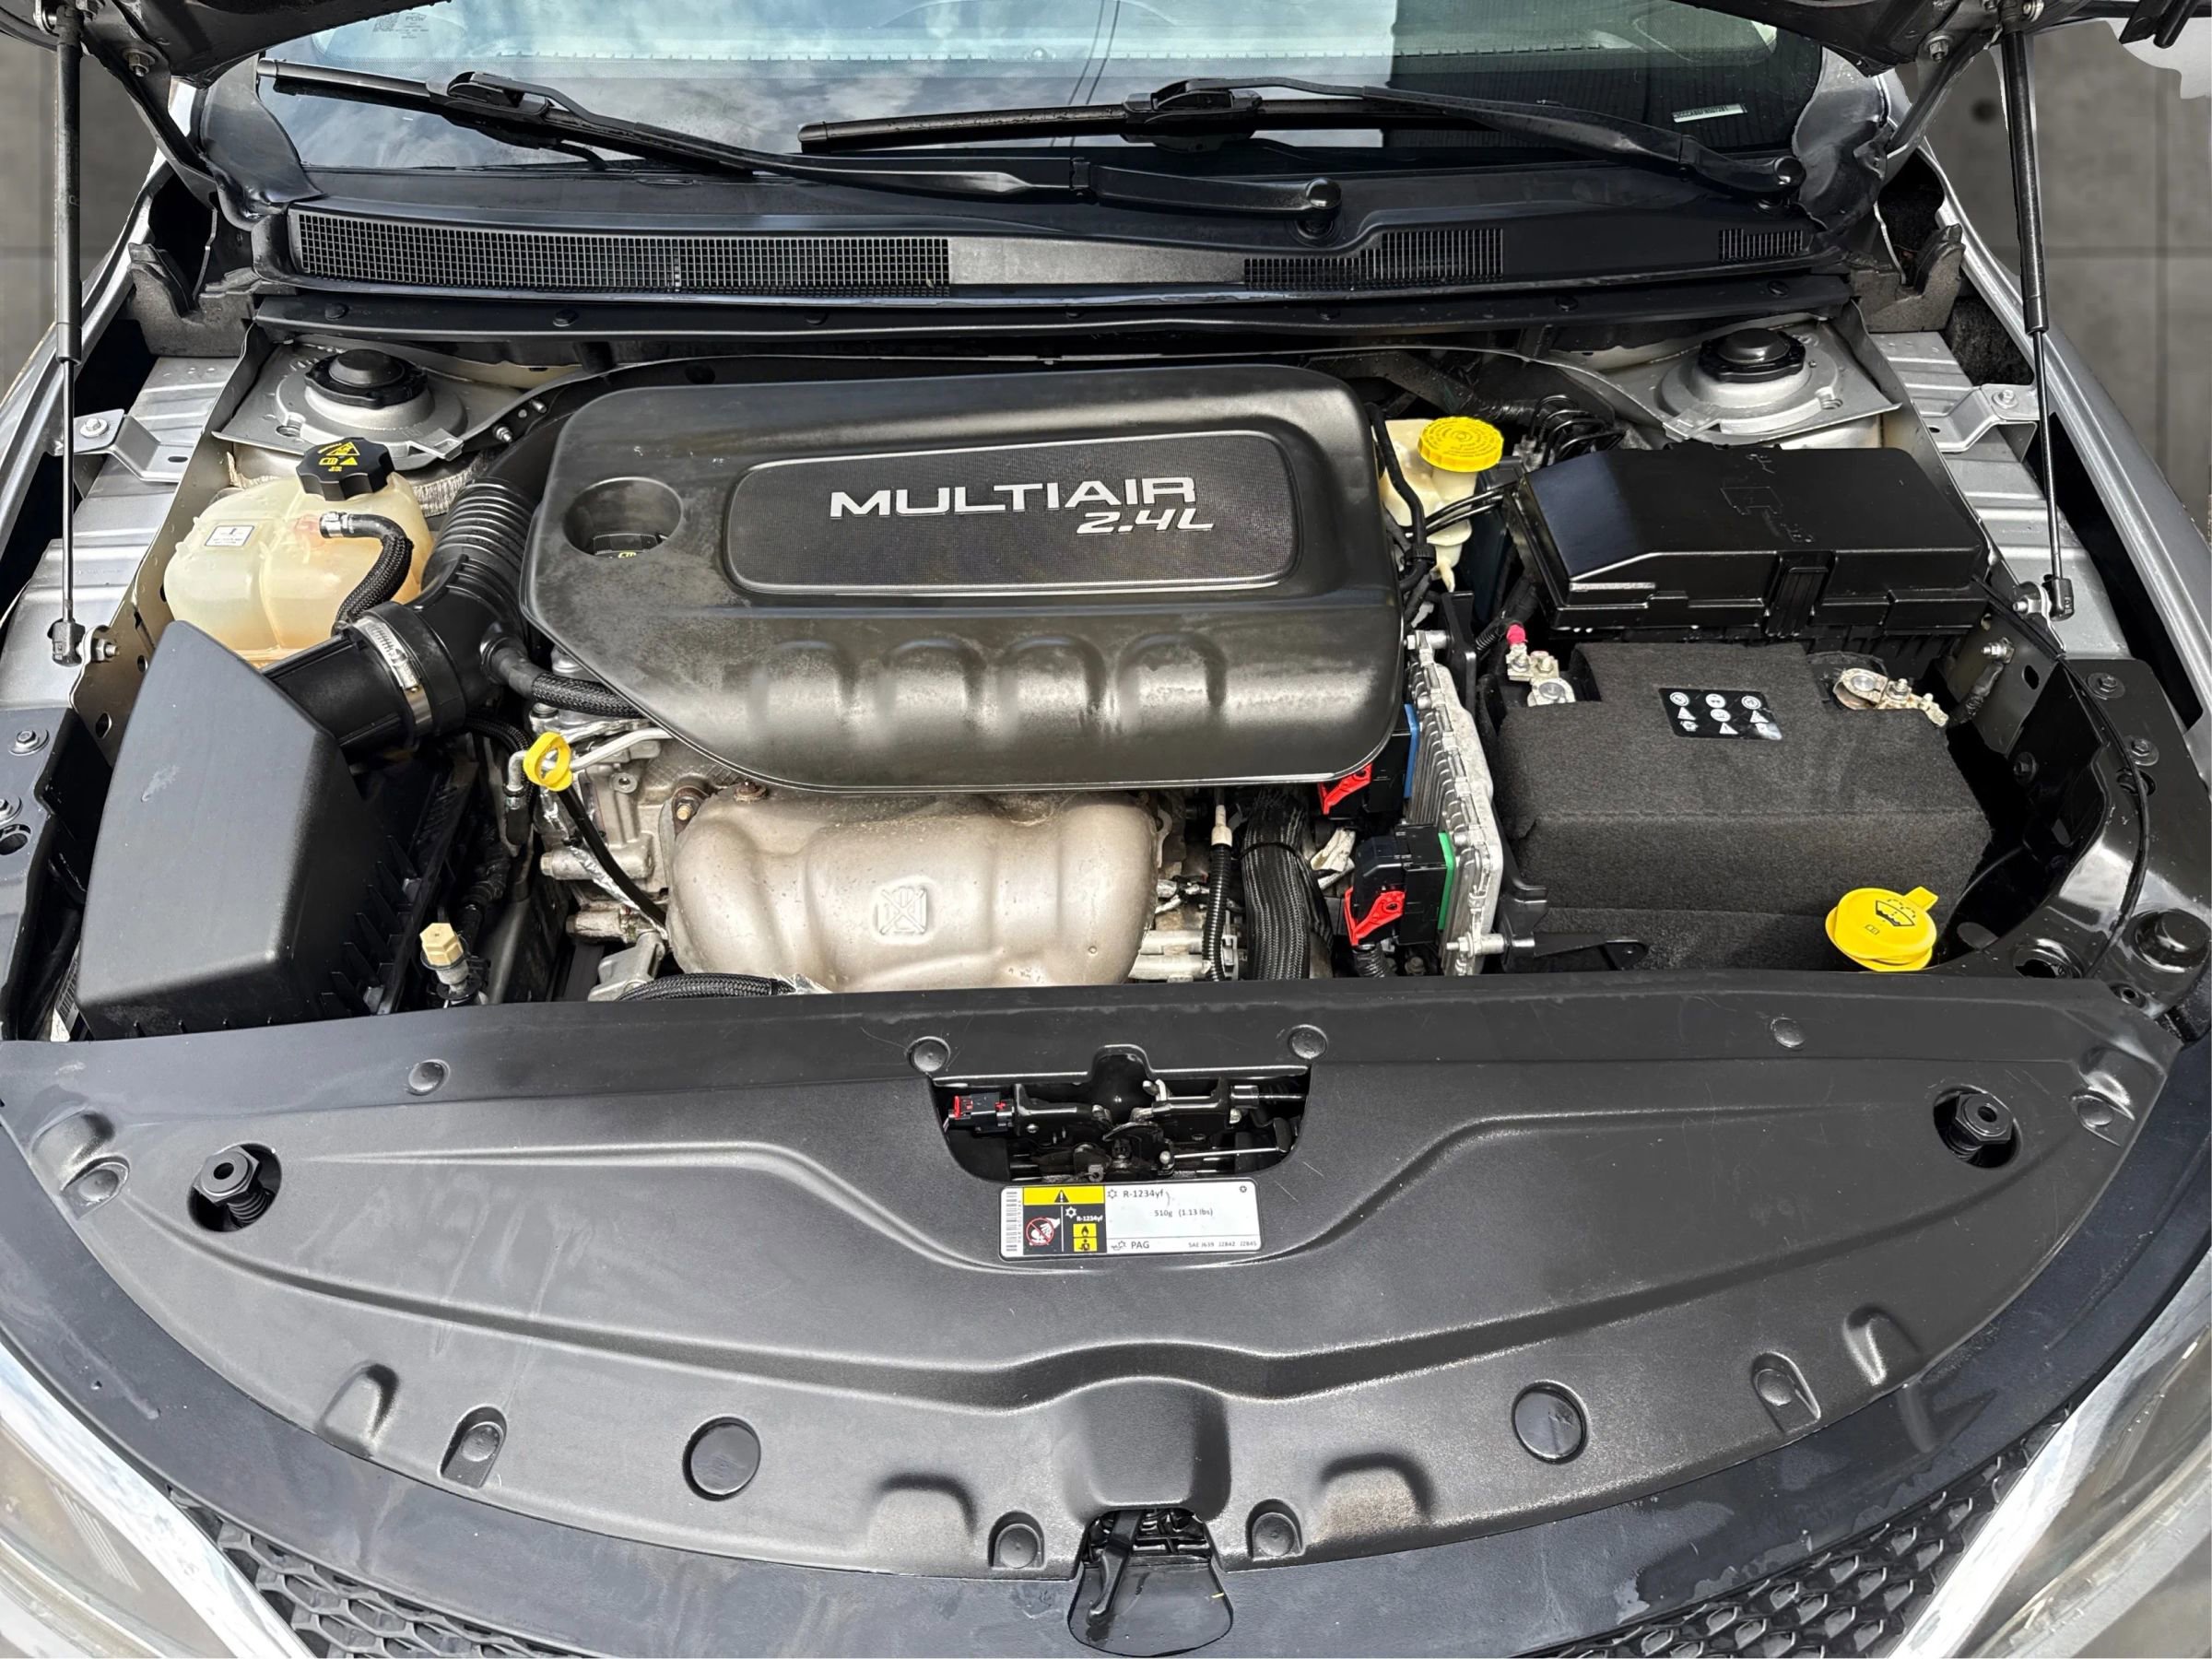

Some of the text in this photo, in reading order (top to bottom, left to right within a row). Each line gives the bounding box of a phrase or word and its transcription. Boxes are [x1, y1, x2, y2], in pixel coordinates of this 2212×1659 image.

[830, 477, 1196, 519] MULTIAIR
[1077, 508, 1215, 535] 2.4L
[1123, 1188, 1164, 1199] R-1234yf
[1154, 1207, 1214, 1218] 510g (1.13 lbs)
[1131, 1240, 1150, 1250] PAG
